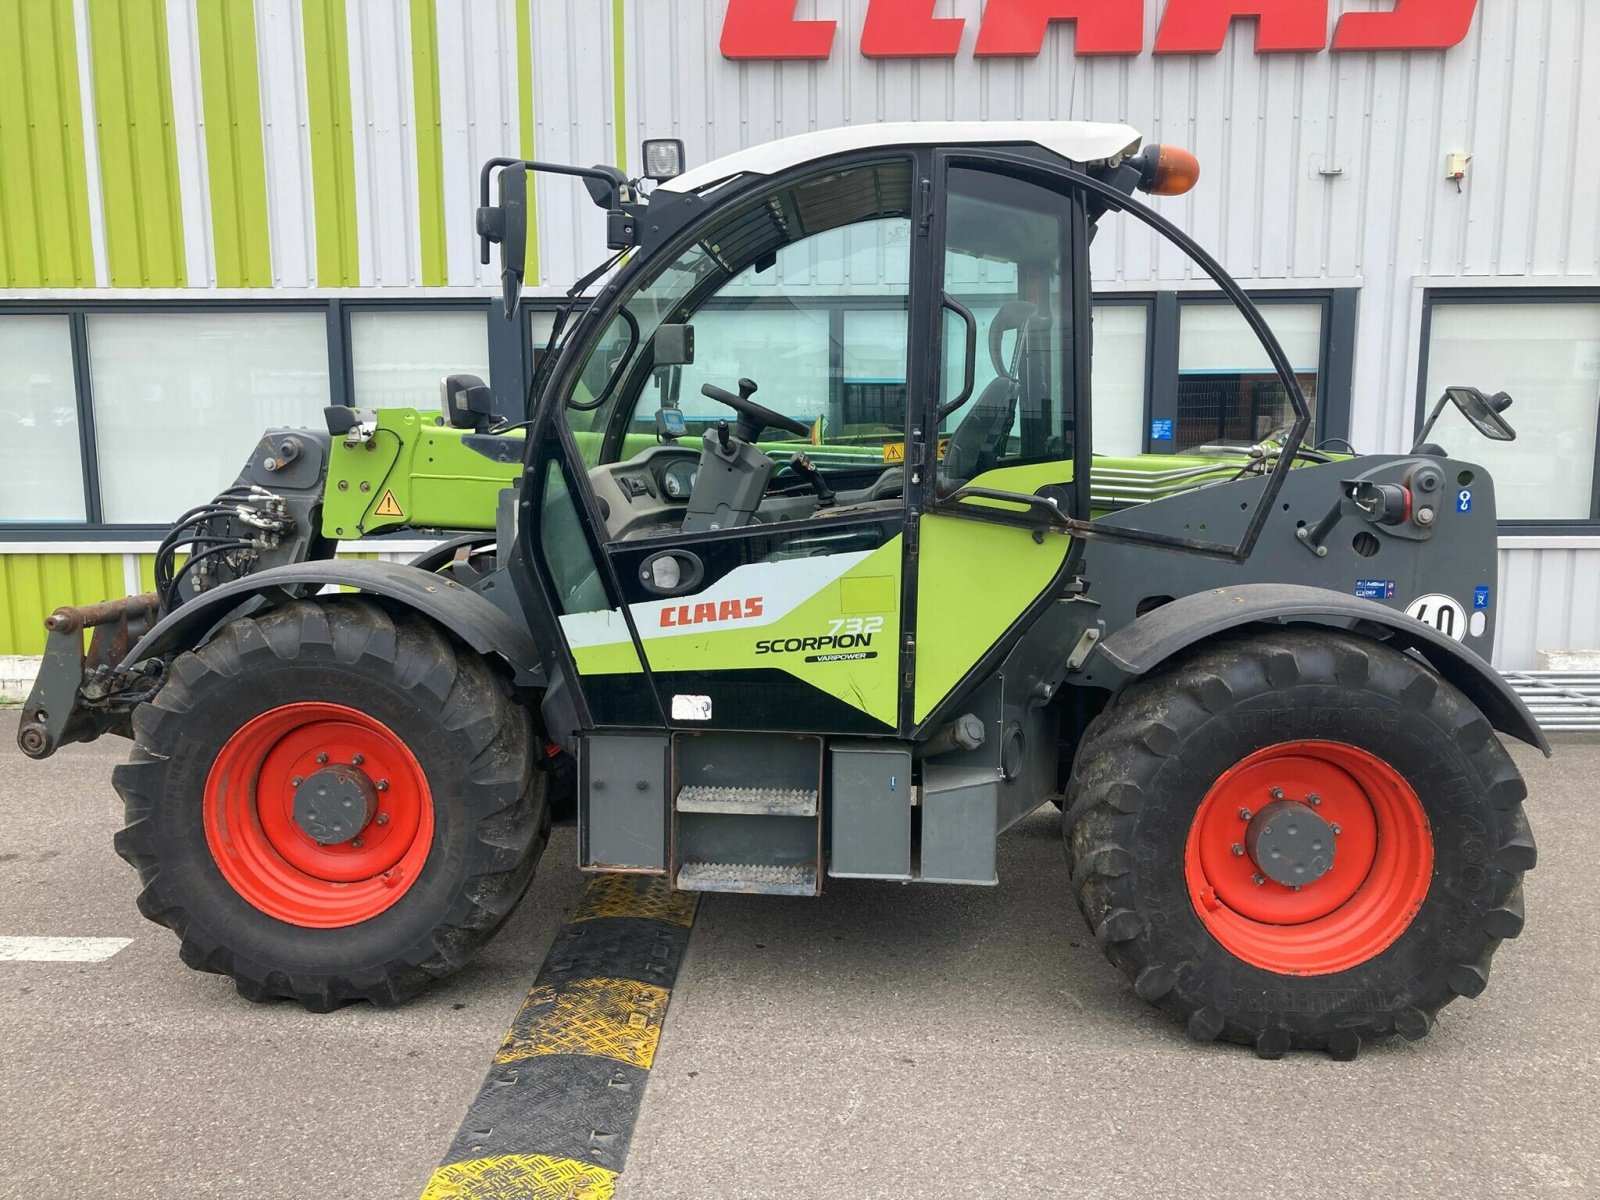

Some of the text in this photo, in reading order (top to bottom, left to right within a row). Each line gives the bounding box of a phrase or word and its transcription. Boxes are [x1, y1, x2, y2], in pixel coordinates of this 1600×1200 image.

[660, 598, 763, 626] CLAAS
[827, 616, 884, 638] 732
[756, 633, 872, 654] SCORPION
[817, 653, 867, 662] VARIPOWER
